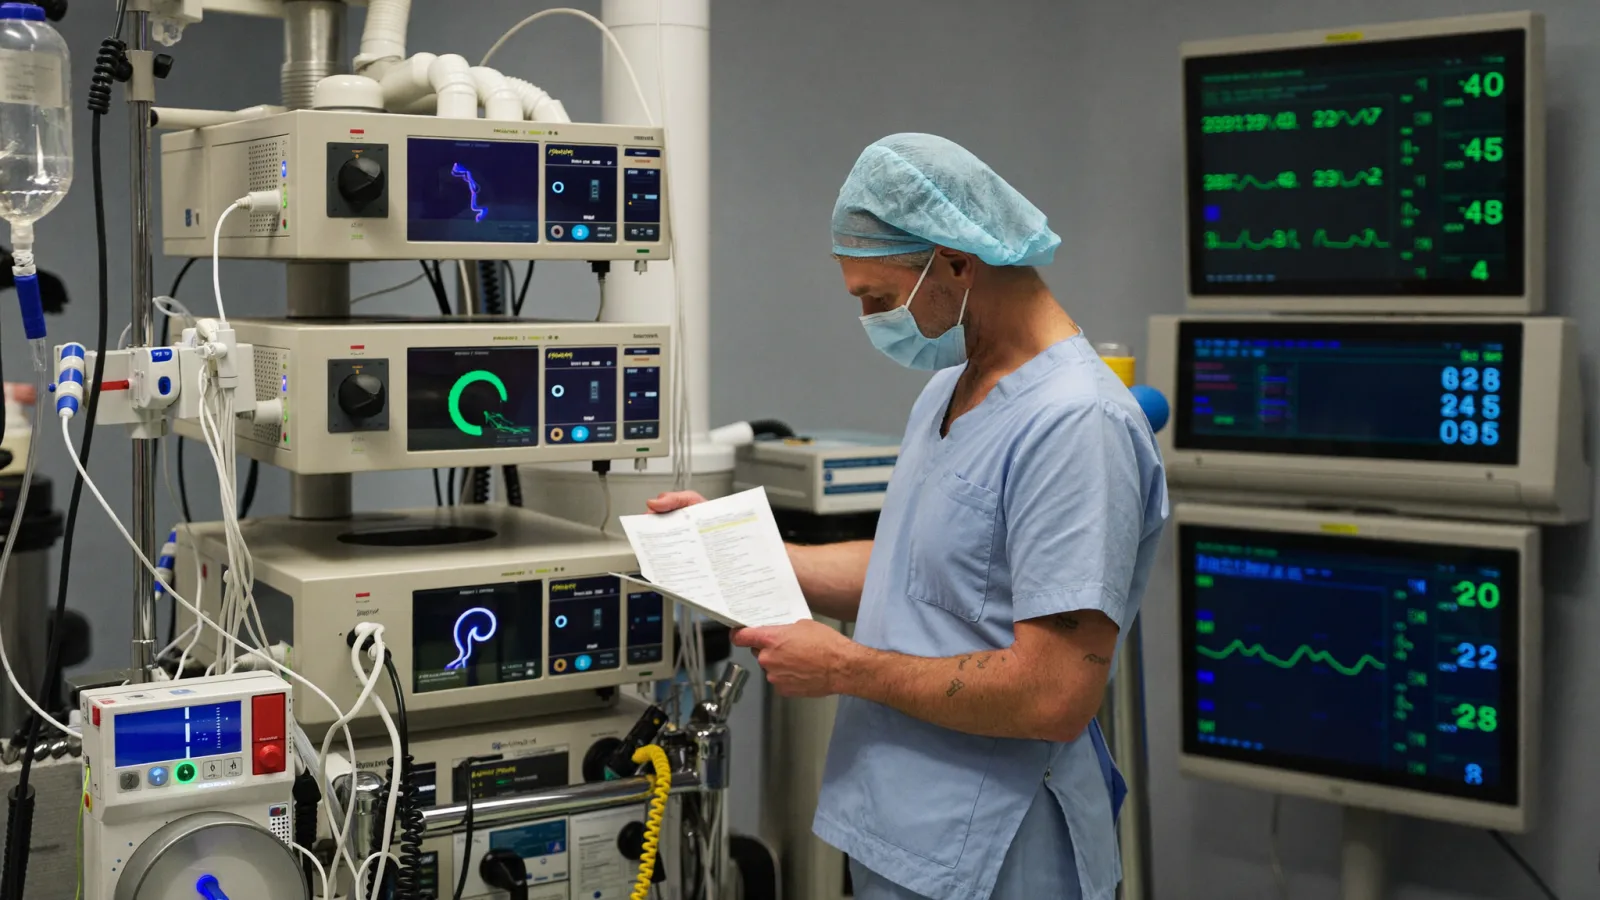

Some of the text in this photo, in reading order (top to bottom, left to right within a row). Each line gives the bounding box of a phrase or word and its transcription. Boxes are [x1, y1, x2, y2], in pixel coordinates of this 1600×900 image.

[1464, 71, 1505, 98] 40
[1464, 136, 1504, 162] 45
[1455, 580, 1500, 609] 20
[1457, 641, 1497, 670] 22
[1456, 703, 1497, 732] 28
